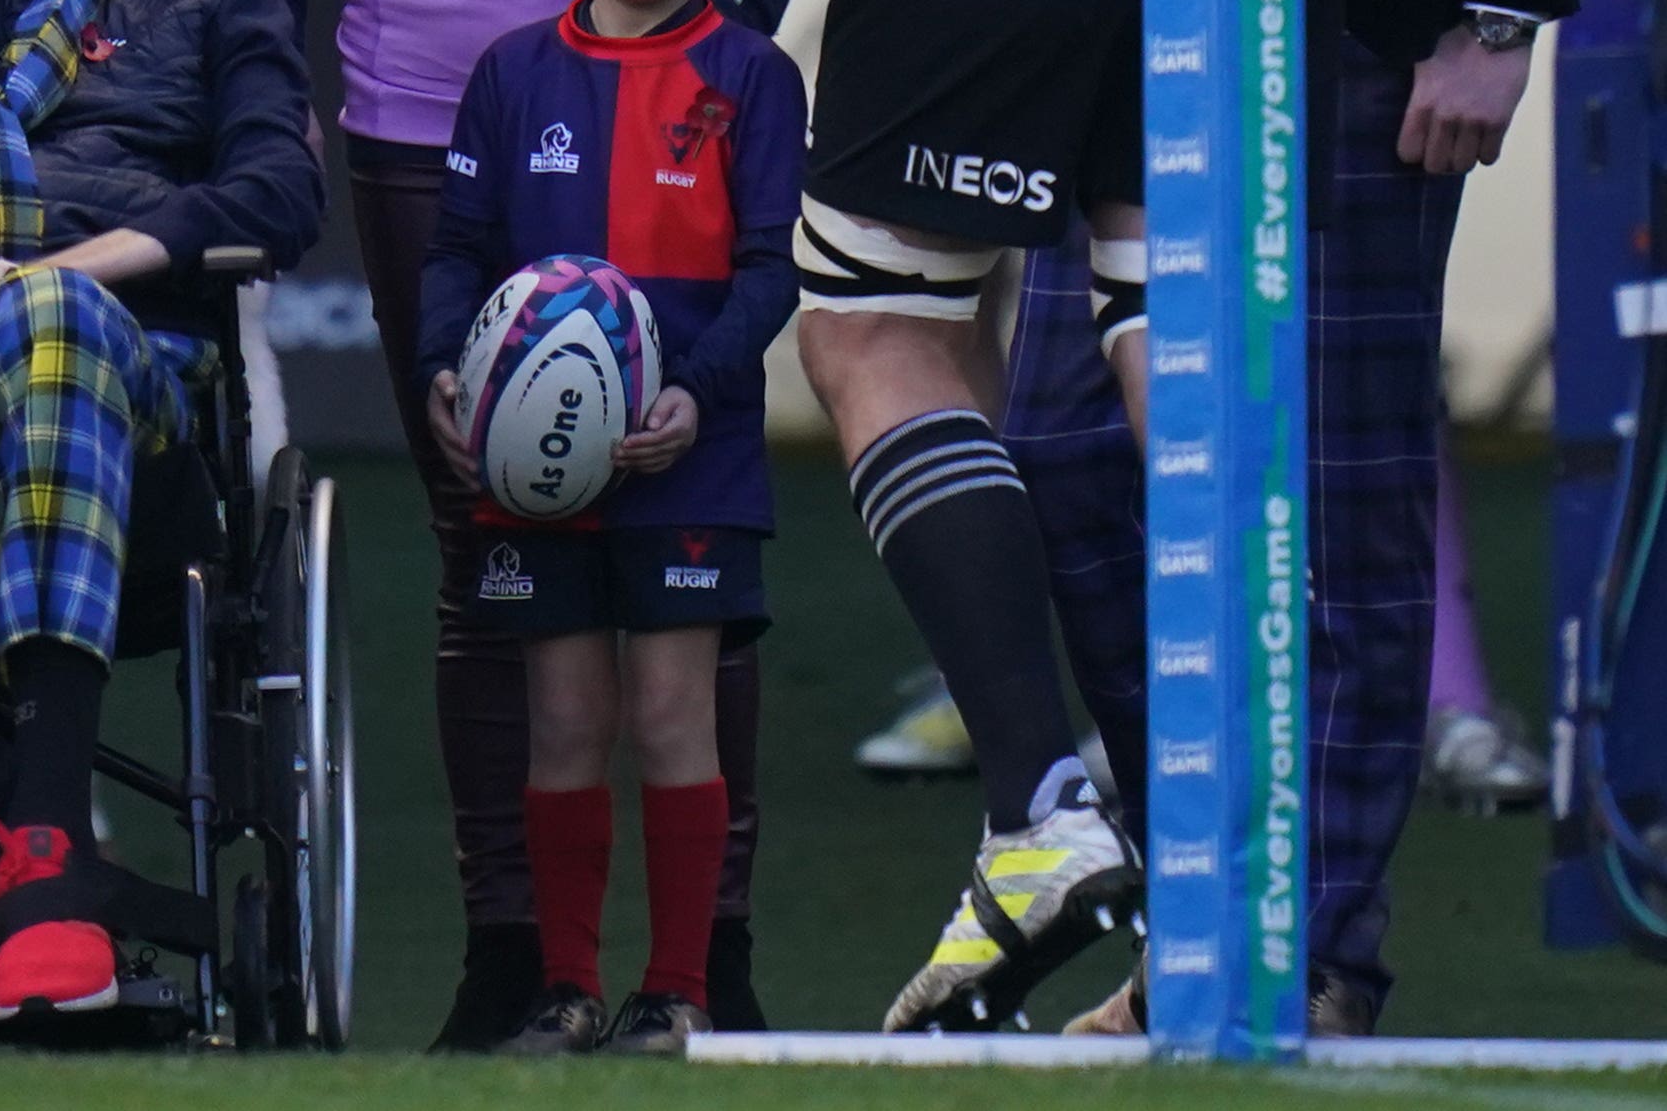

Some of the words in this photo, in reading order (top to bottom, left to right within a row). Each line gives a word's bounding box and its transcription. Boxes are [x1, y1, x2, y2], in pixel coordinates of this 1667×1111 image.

[1151, 52, 1202, 75] GAME
[1152, 151, 1204, 175] GAME
[656, 171, 697, 189] RUGBY
[903, 144, 1057, 212] INEOS
[1154, 254, 1205, 276] GAME
[539, 388, 582, 459] One
[1156, 450, 1209, 476] GAME
[529, 466, 565, 499] As
[1158, 554, 1209, 577] GAME
[481, 580, 534, 595] RHINO
[665, 573, 719, 590] RUGBY
[1159, 655, 1209, 677] GAME
[1258, 493, 1300, 974] #EveryonesGame
[1160, 755, 1209, 777] GAME
